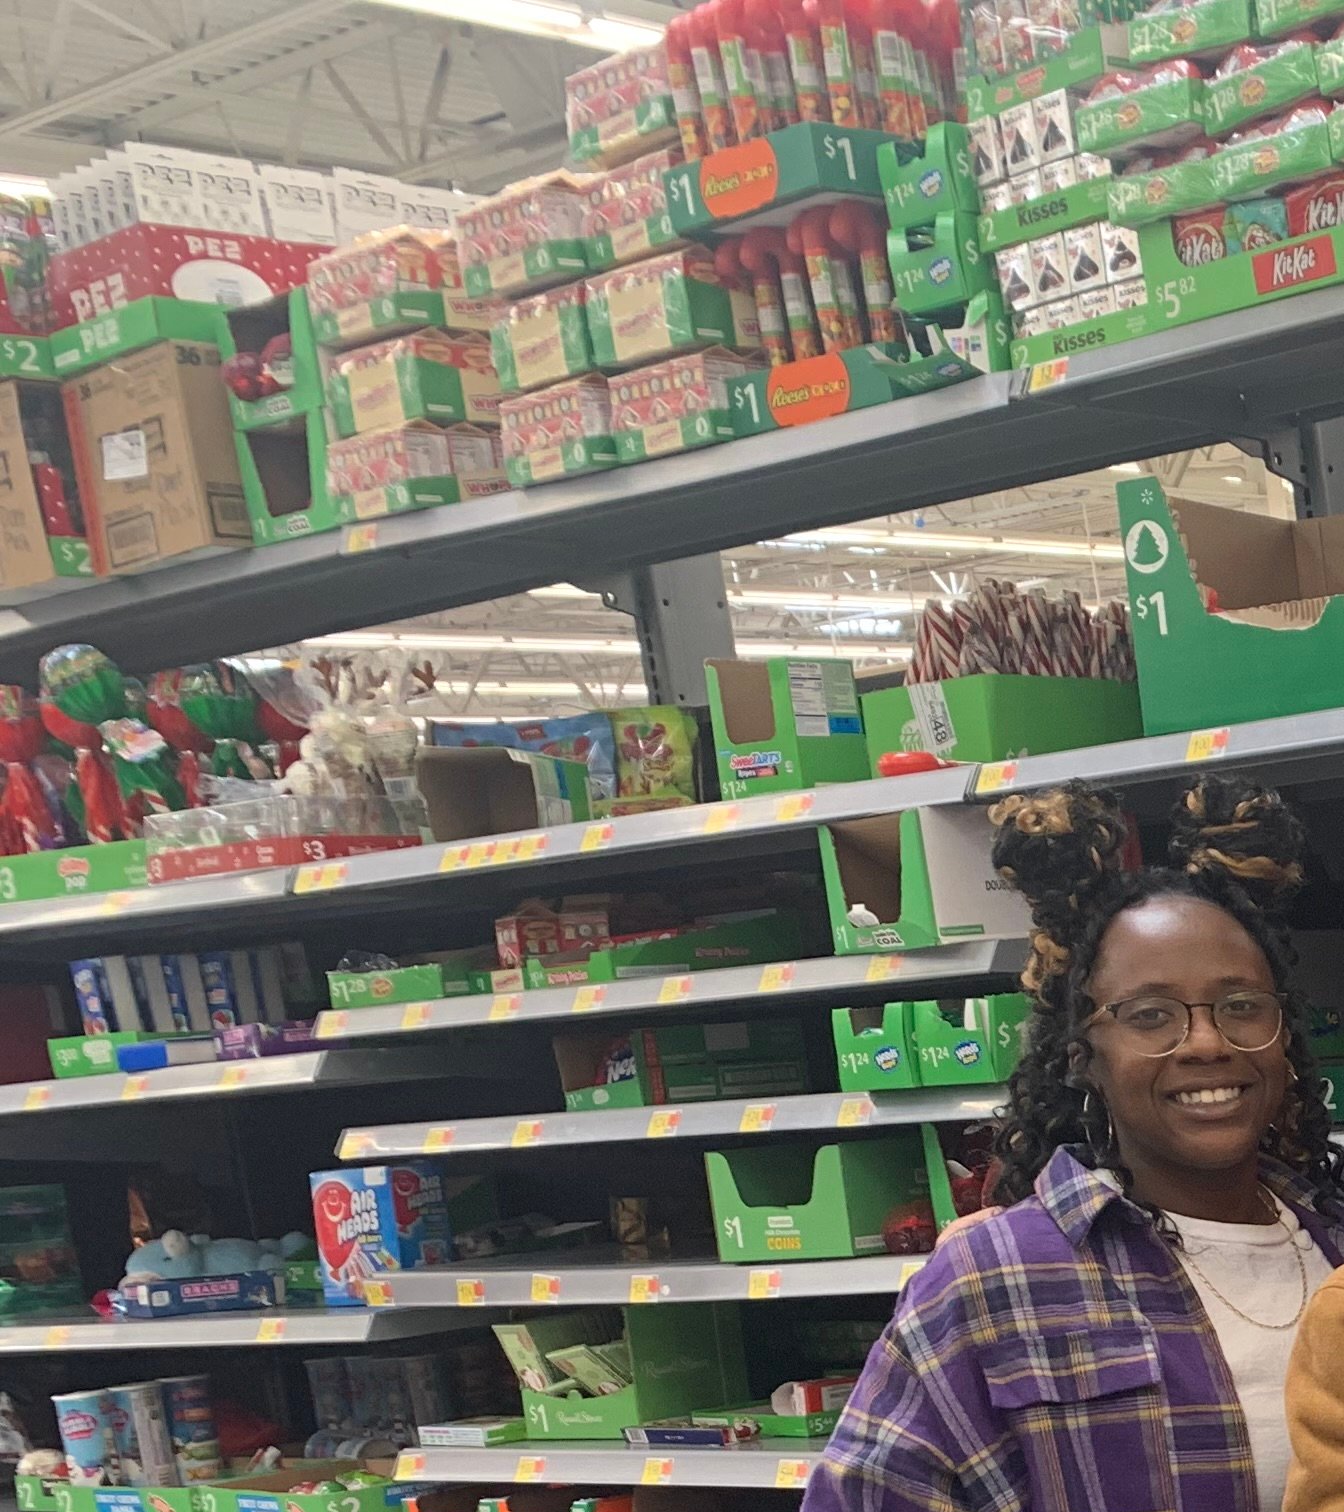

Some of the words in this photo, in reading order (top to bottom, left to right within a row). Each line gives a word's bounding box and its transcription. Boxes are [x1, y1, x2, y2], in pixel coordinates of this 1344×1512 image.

[824, 135, 857, 180] $1
[670, 173, 696, 216] $1
[1155, 275, 1197, 319] $582
[3, 340, 41, 372] $2
[734, 382, 761, 423] $1
[1136, 590, 1169, 636] $1
[841, 1052, 870, 1075] $124
[724, 1216, 746, 1249] $1
[529, 1403, 550, 1433] $1
